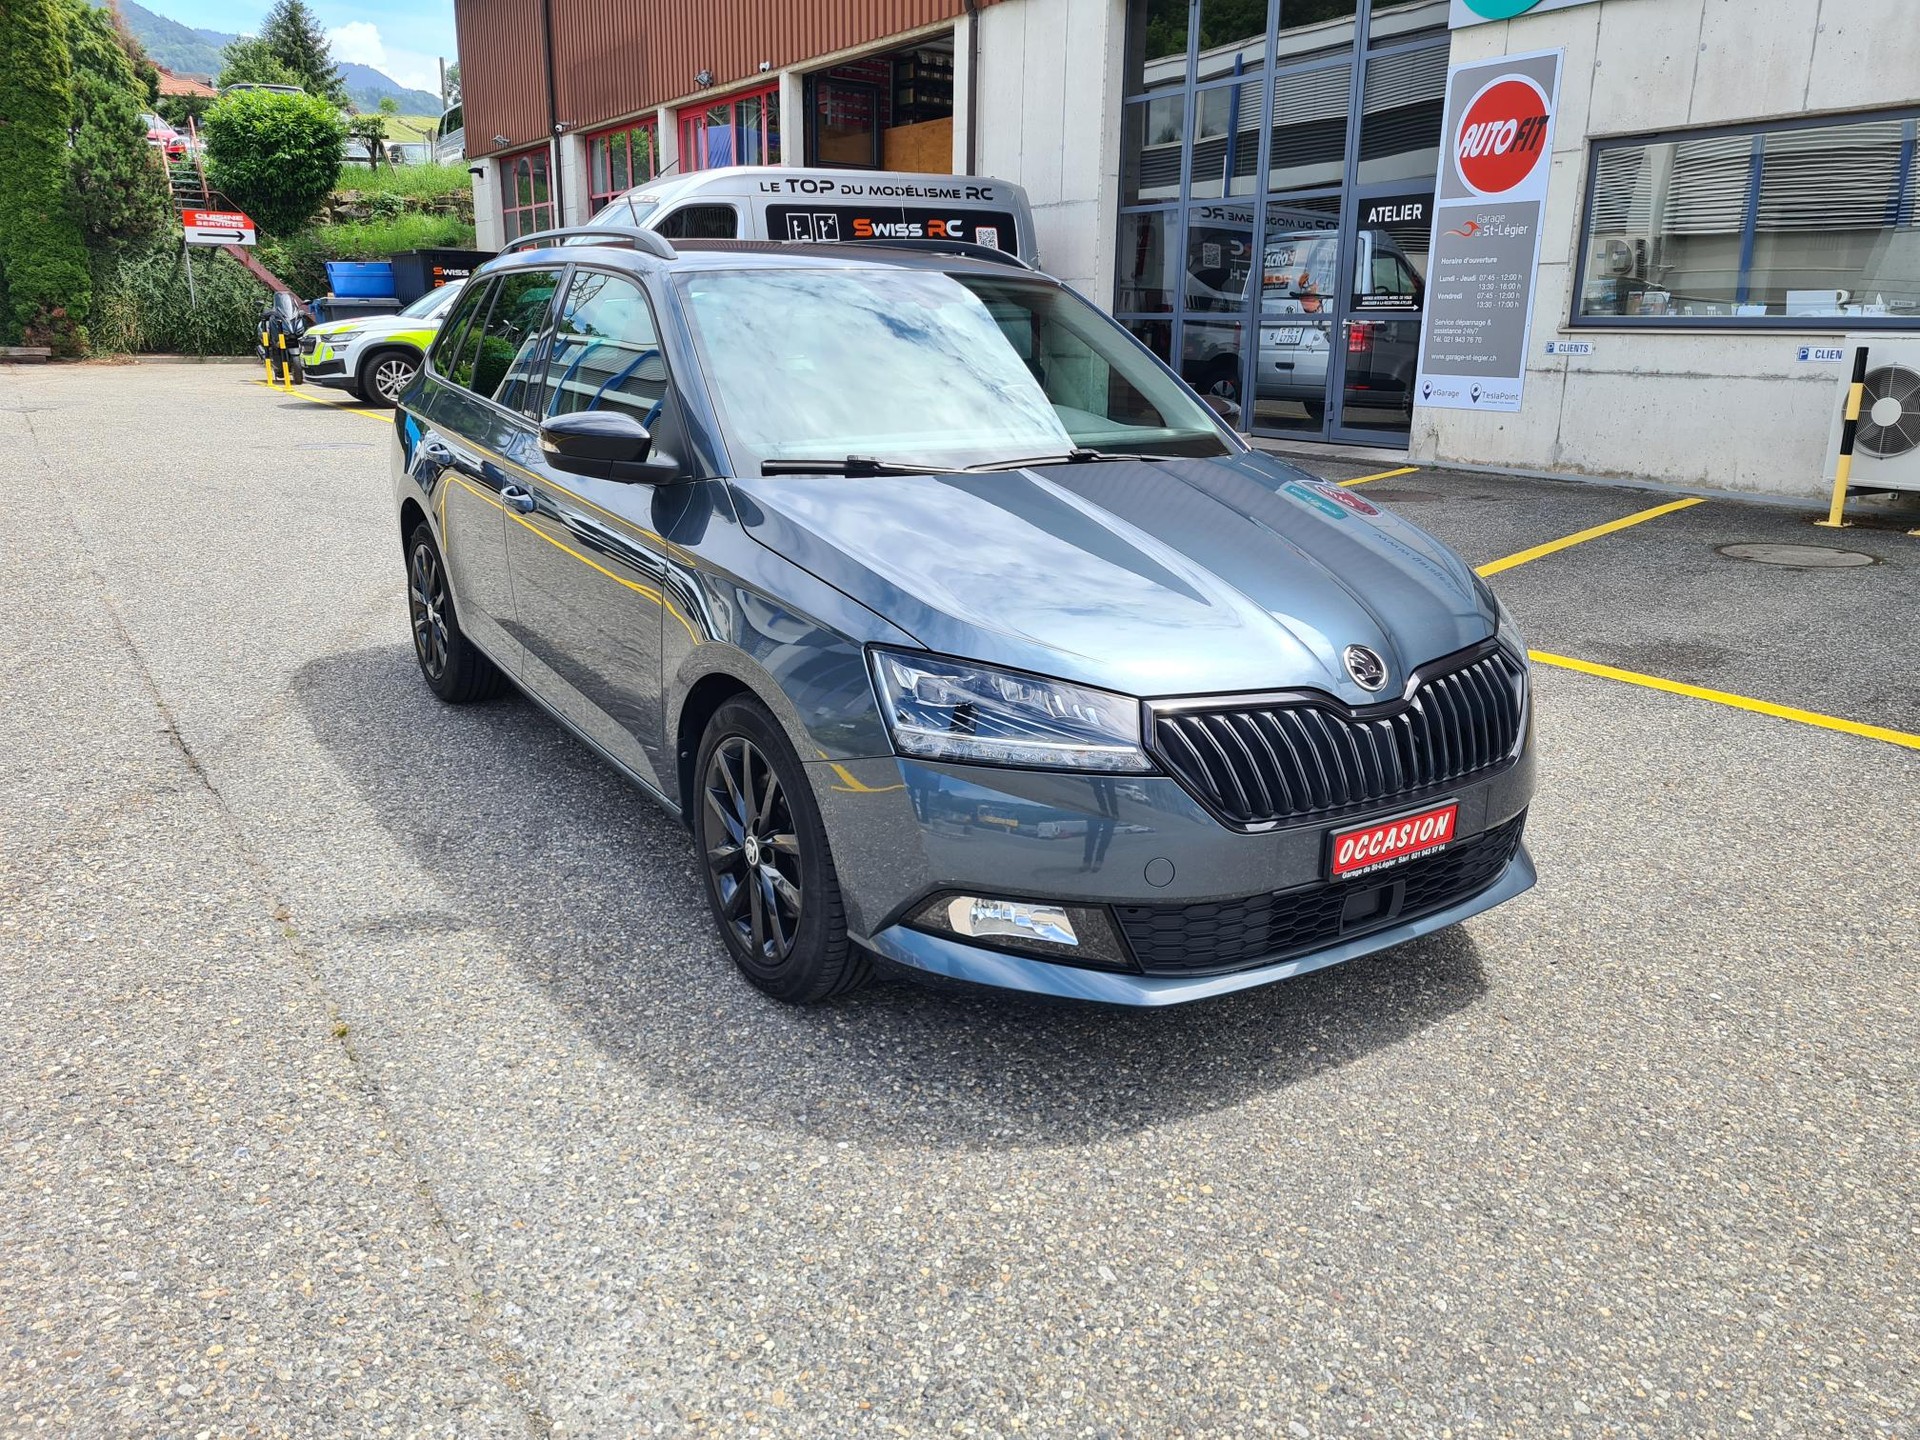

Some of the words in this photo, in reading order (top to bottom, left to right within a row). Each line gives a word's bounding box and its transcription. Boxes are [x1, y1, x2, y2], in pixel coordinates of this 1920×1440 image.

[760, 182, 781, 192] LE
[785, 179, 835, 194] TOP
[841, 184, 864, 195] DU
[869, 185, 961, 199] MODÉLISME
[966, 187, 994, 200] RC
[194, 213, 244, 221] CUISINE
[1368, 203, 1422, 223] ATELIER
[1476, 213, 1506, 224] Garage
[195, 220, 244, 228] SERVICES
[927, 219, 963, 237] RC
[1483, 223, 1529, 238] St-Légier
[1441, 257, 1462, 265] Horaire
[1460, 274, 1476, 282] Jeudi
[1455, 319, 1486, 327] dépannage
[1558, 343, 1589, 353] CLIENTS
[1815, 349, 1843, 360] CLIEN
[1432, 389, 1460, 398] eGarage
[1338, 812, 1450, 865] OCCASION
[1341, 868, 1363, 879] Garage
[1371, 859, 1397, 872] St-Légier
